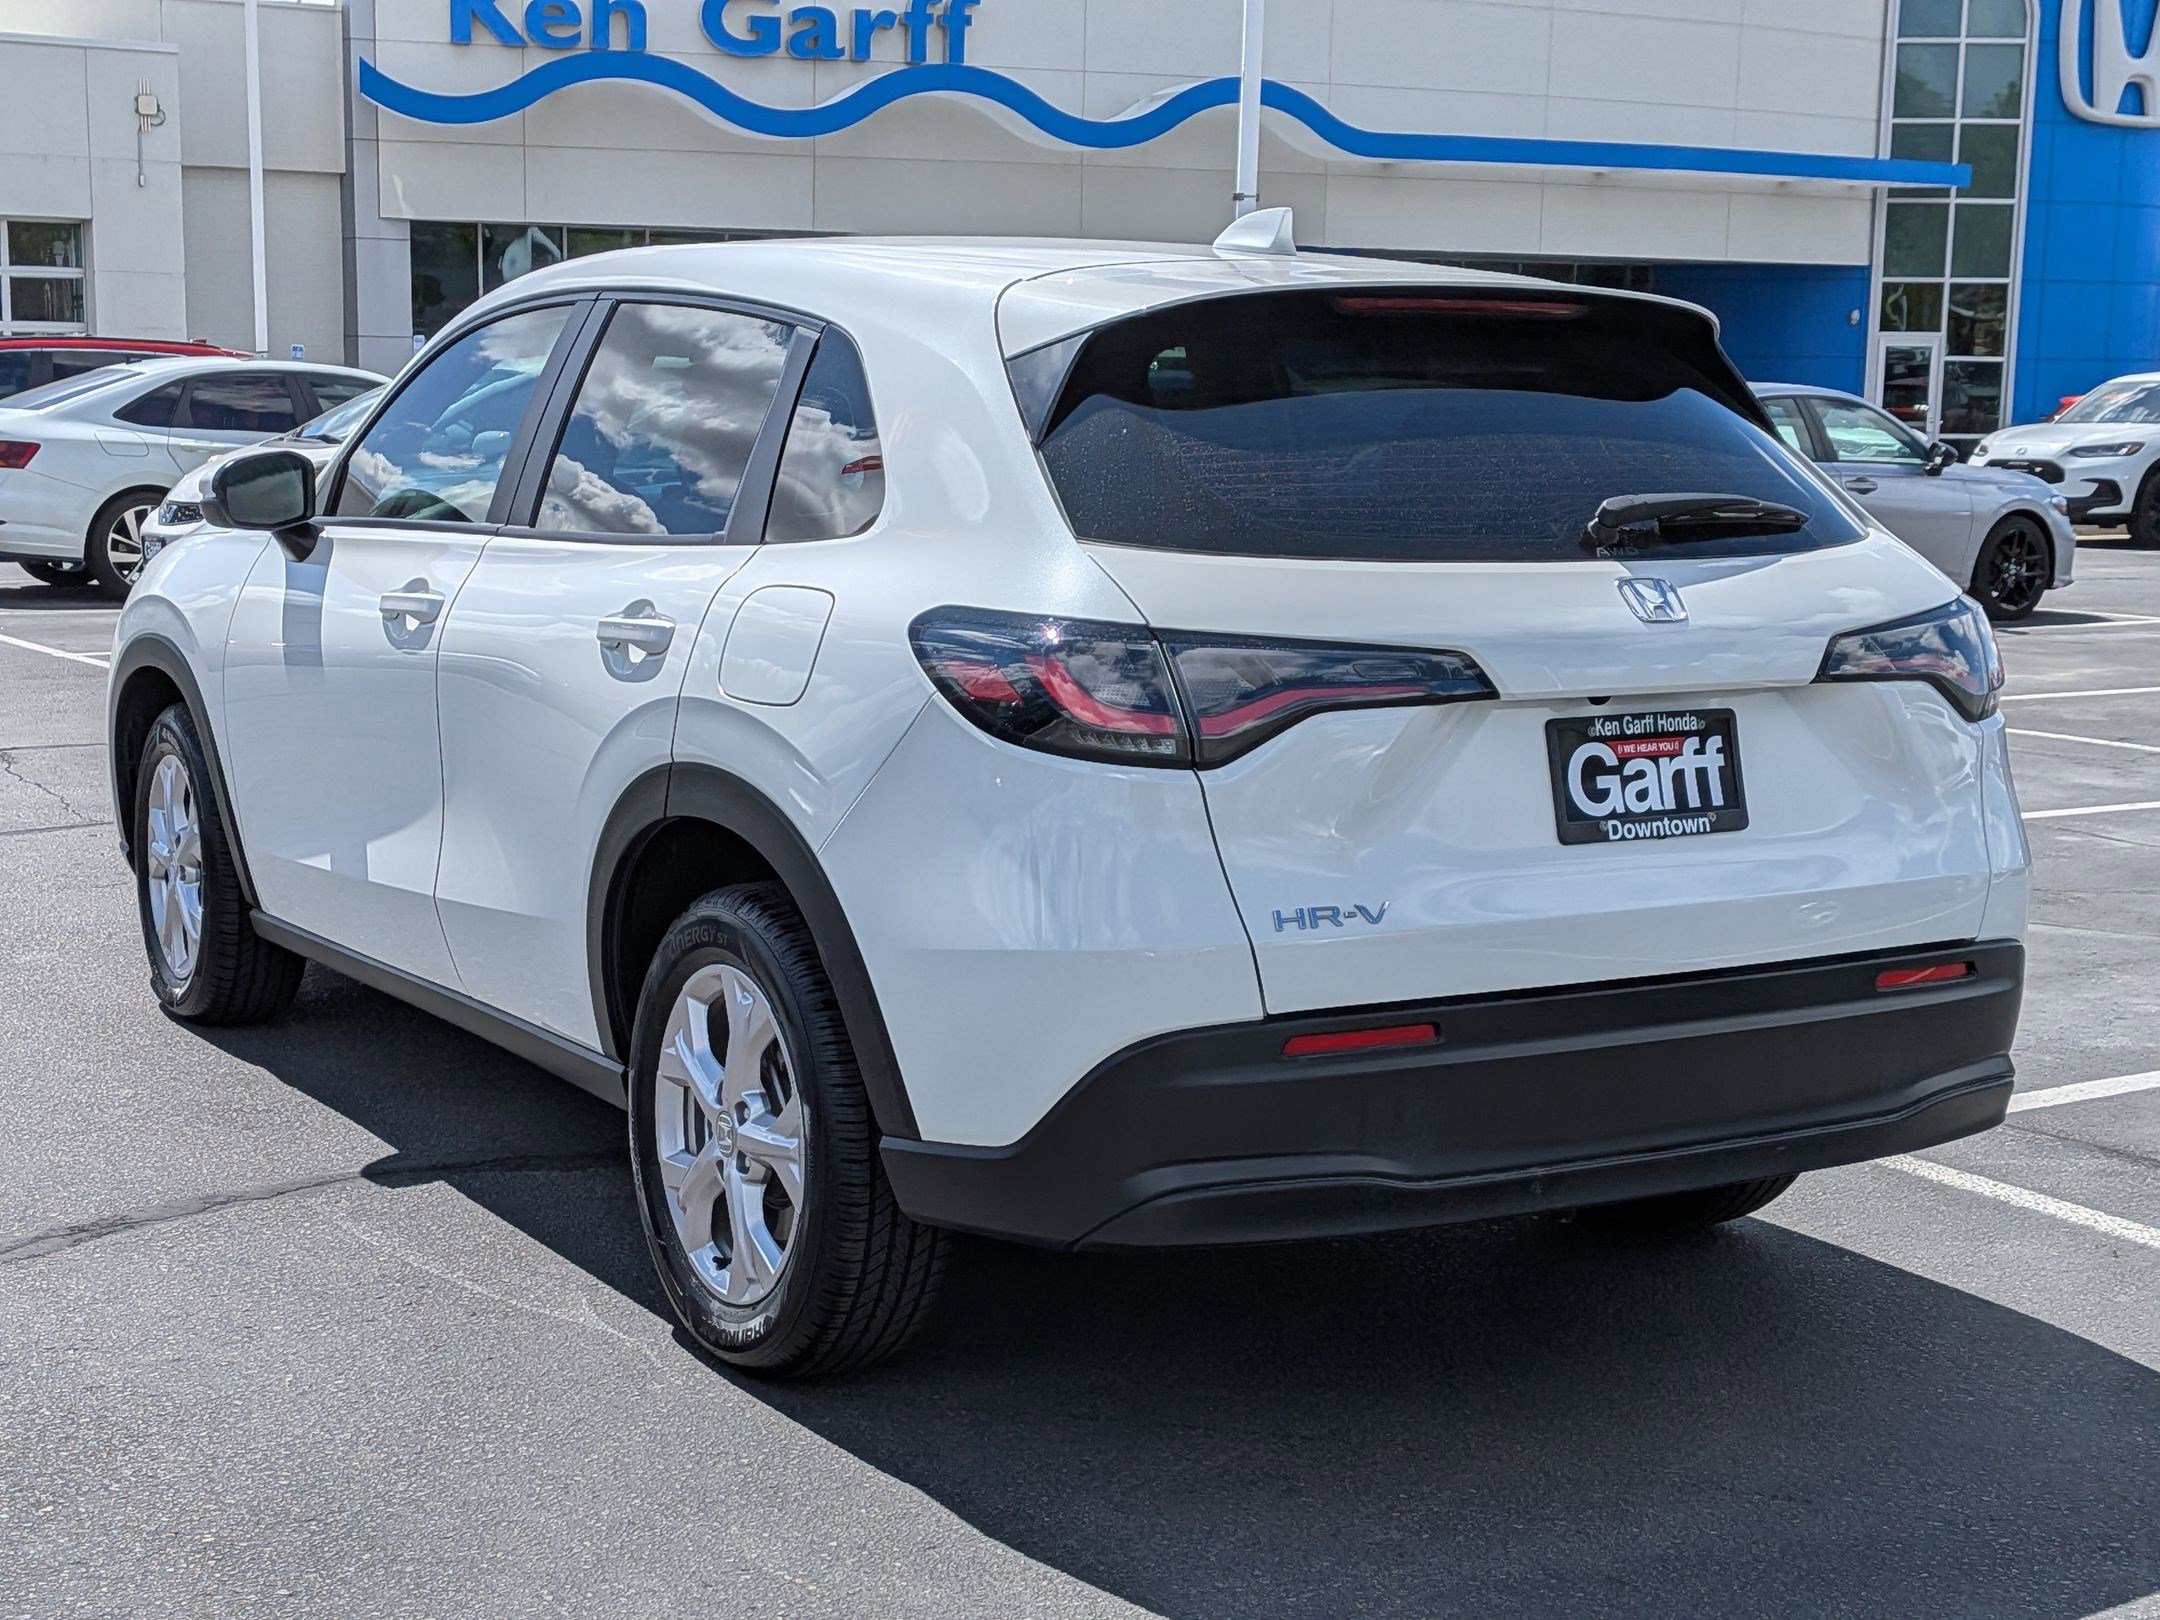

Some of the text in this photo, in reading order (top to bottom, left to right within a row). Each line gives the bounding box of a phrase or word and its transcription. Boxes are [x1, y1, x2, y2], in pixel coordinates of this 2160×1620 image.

[450, 0, 981, 65] Ken Garff
[1595, 712, 1698, 736] Ken Garff Honda
[1624, 741, 1675, 753] WE HEAR YOU
[1567, 735, 1725, 817] Garff
[1608, 816, 1711, 840] Downtown
[1272, 900, 1391, 932] HR-V
